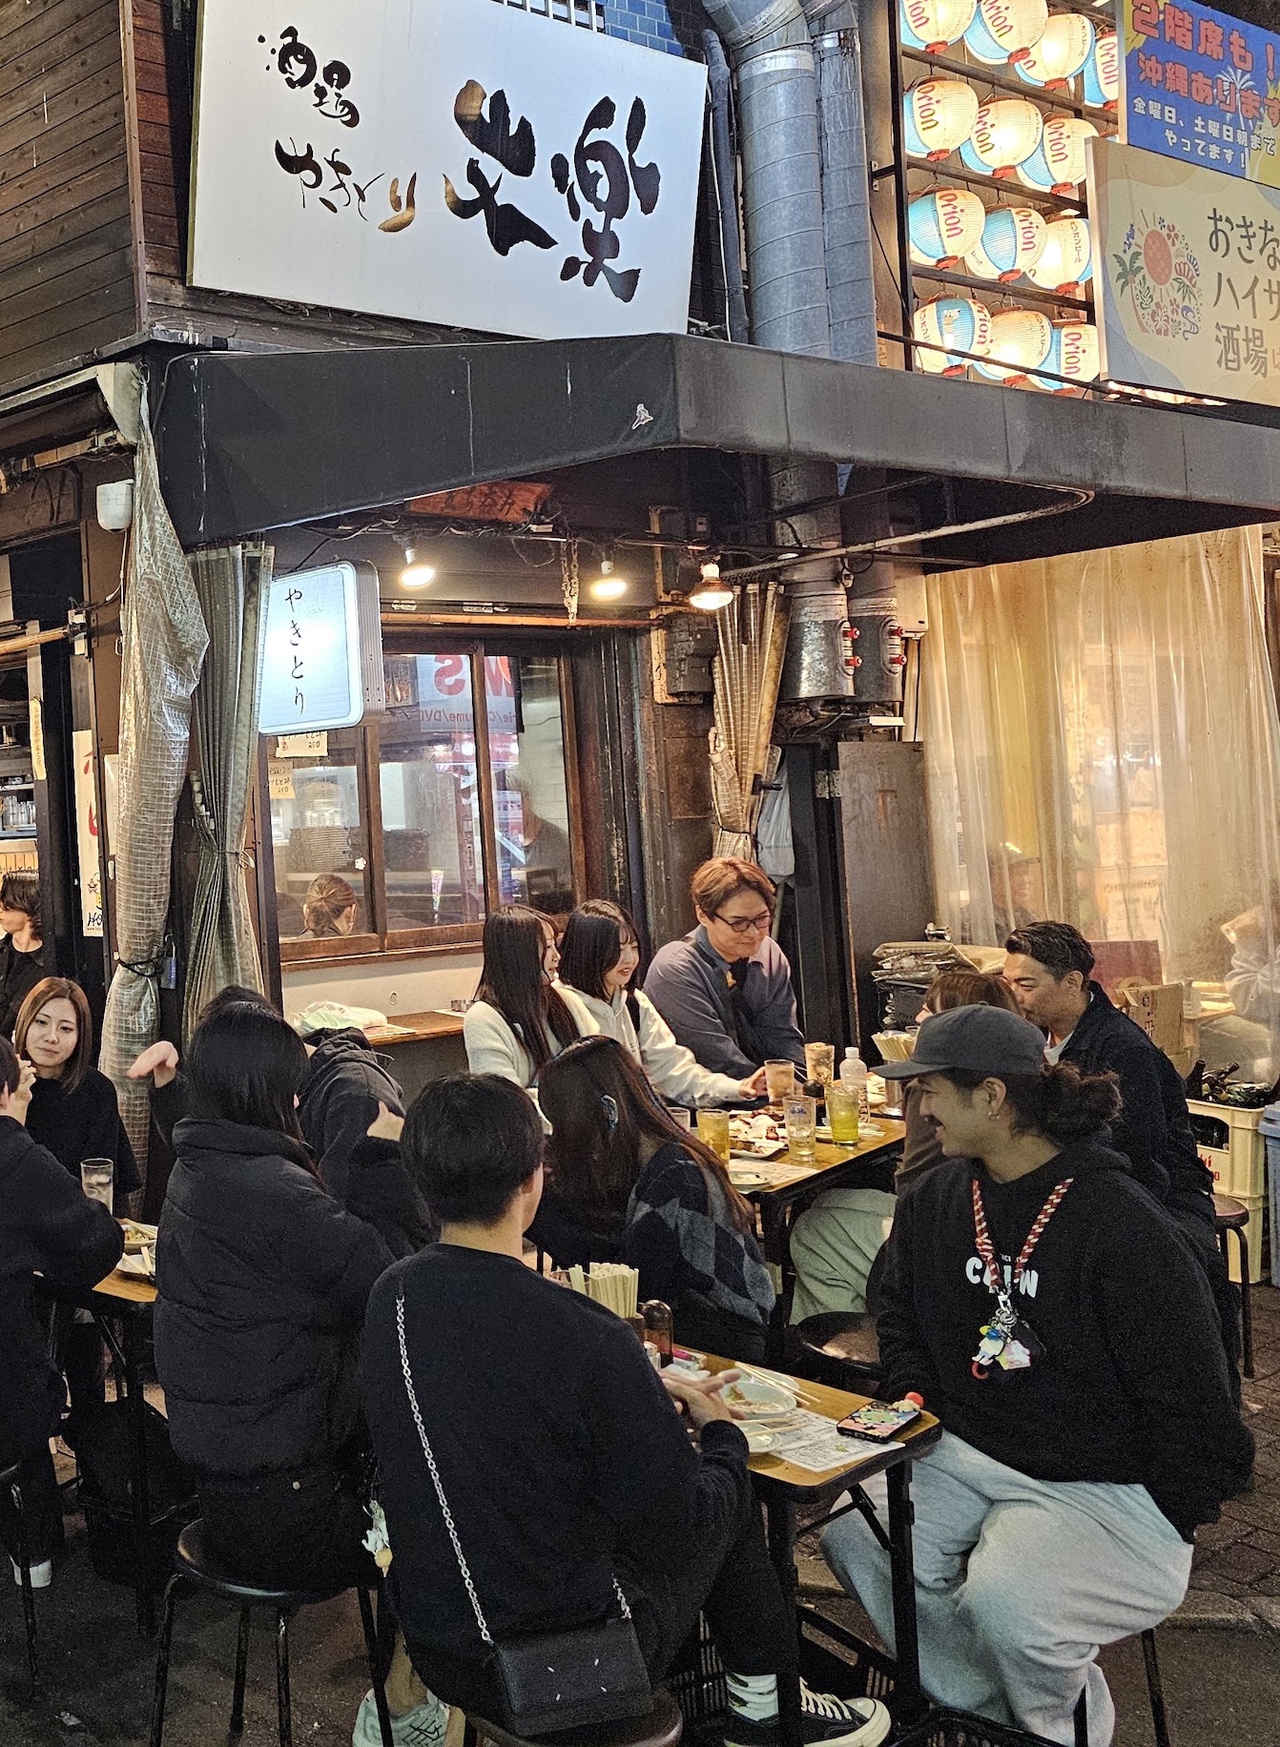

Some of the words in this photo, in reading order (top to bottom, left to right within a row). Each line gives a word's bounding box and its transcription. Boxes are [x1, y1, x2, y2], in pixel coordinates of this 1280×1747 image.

[1100, 41, 1119, 86] Orion
[917, 84, 939, 131] Orion
[1138, 51, 1280, 127] 沖縄あります
[977, 107, 996, 154] Orion
[1047, 120, 1069, 164] Orion
[938, 193, 964, 238] Orion
[1015, 209, 1040, 252] Orion
[1207, 207, 1280, 271] おきな
[1064, 331, 1086, 374] Orion
[285, 588, 304, 716] やきとり
